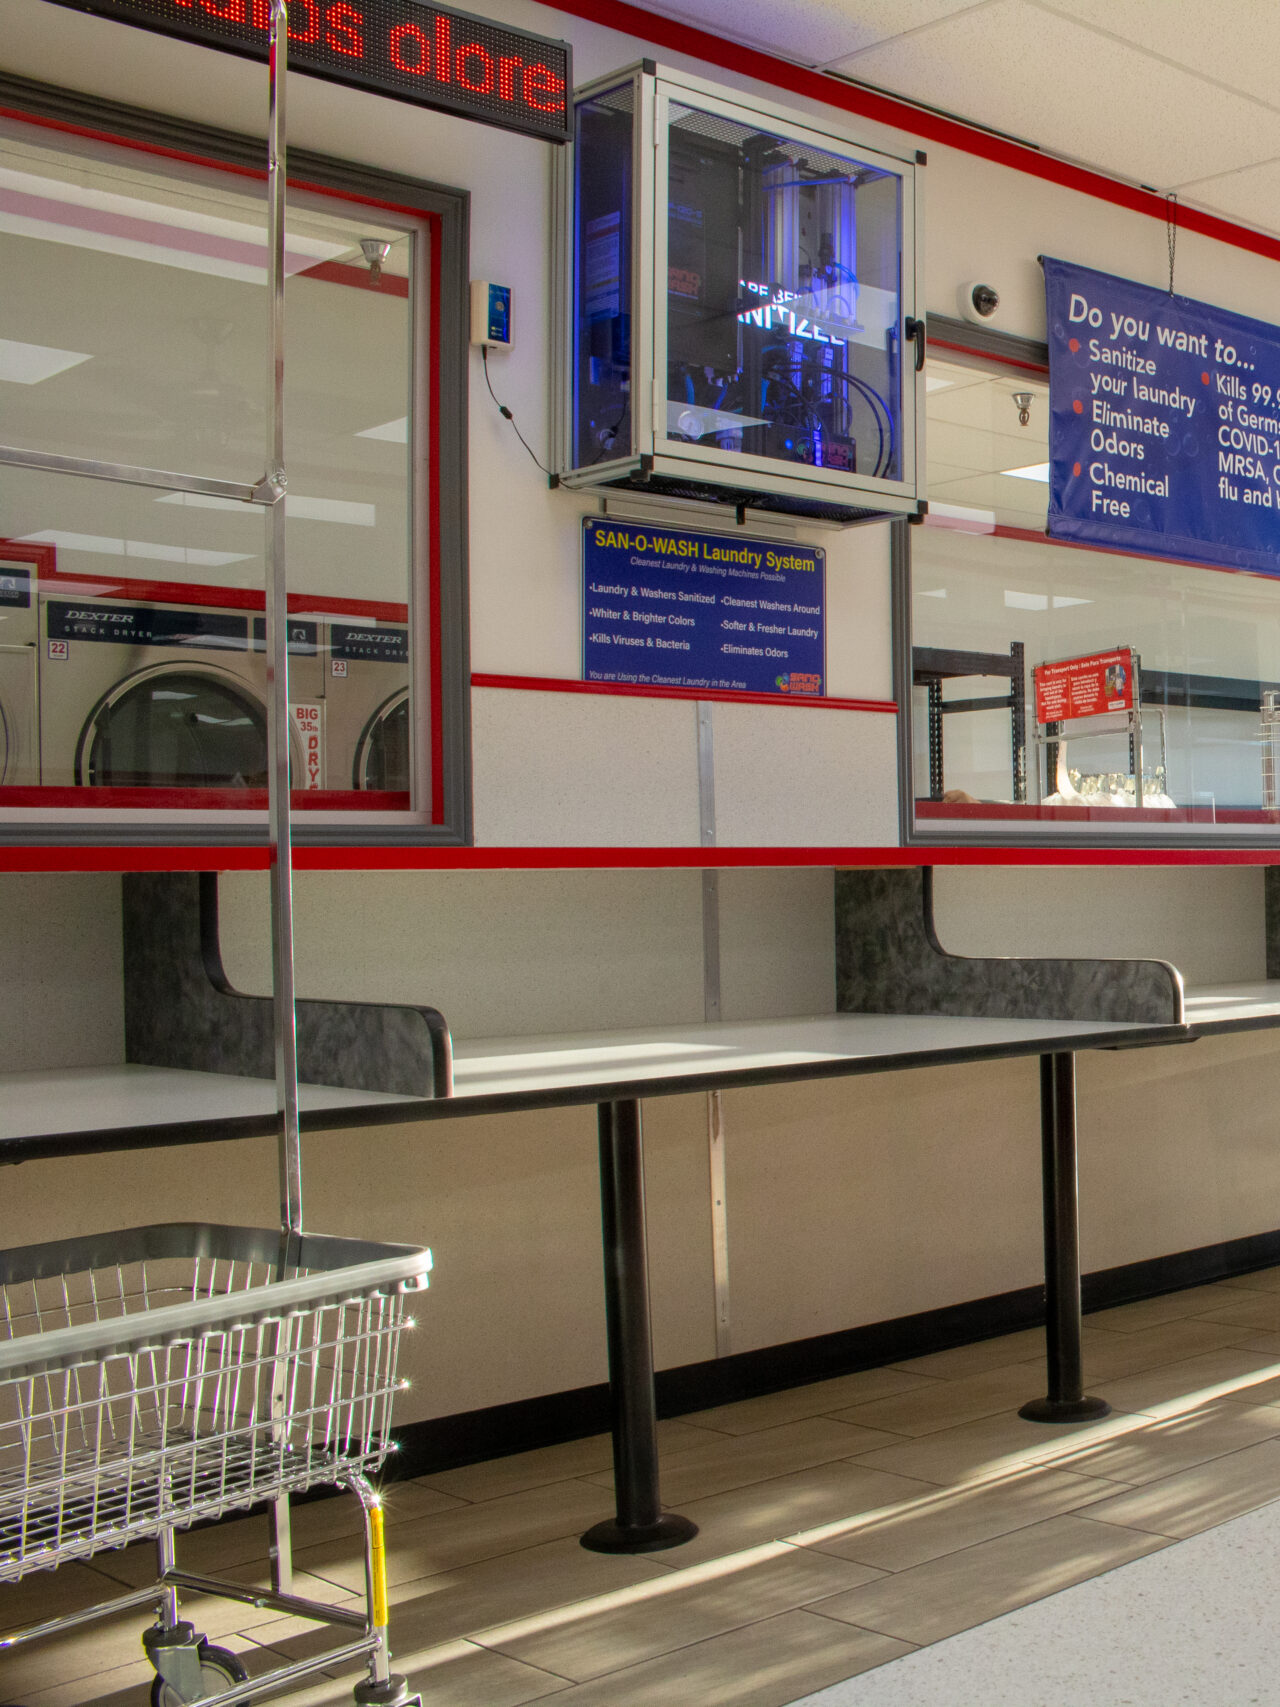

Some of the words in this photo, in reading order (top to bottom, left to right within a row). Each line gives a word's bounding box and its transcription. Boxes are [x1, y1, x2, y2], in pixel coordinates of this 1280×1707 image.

[390, 15, 565, 112] olore
[1068, 293, 1103, 328] Do
[1110, 311, 1150, 341] you
[1156, 325, 1208, 358] want
[1214, 338, 1255, 371] to...
[1088, 338, 1157, 376] Sanitize
[1090, 372, 1128, 397] your
[1133, 377, 1196, 418] laundry
[1215, 373, 1247, 401] Kills
[1092, 400, 1170, 438] Eliminate
[1218, 401, 1233, 421] of
[1090, 429, 1145, 460] Odors
[1218, 451, 1269, 484] MRSA,
[1089, 462, 1169, 498] Chemical
[1218, 476, 1238, 501] flu
[1243, 486, 1272, 508] and
[1091, 490, 1131, 518] Free
[595, 529, 699, 558] SAN-O-WASH
[703, 543, 762, 569] Laundry
[766, 551, 815, 572] System
[630, 556, 661, 568] Cleanest
[662, 560, 690, 573] Laundry
[691, 563, 697, 572] &
[699, 564, 727, 577] Washing
[728, 568, 759, 579] Machines
[760, 572, 786, 582] Possible
[592, 582, 628, 597] Laundry
[630, 586, 638, 596] &
[640, 587, 677, 600] Washers
[678, 591, 716, 604] Sanitized
[723, 596, 757, 608] Cleanest
[759, 600, 791, 612] Washers
[793, 604, 820, 615] Around
[65, 610, 134, 623] DEXTER
[591, 607, 621, 619] Whiter
[623, 610, 630, 620] &
[632, 611, 666, 624] Brighter
[668, 615, 695, 626] Colors
[64, 625, 105, 635] STACK
[114, 629, 153, 638] DRYER
[345, 632, 402, 644] DEXTER
[723, 620, 746, 631] Softer
[748, 622, 755, 632] &
[757, 623, 786, 634] Fresher
[787, 626, 818, 640] Laundry
[51, 643, 65, 654] 22
[345, 646, 379, 655] STACK
[592, 633, 611, 644] Kills
[612, 634, 644, 646] Viruses
[646, 637, 653, 647] &
[655, 638, 690, 650] Bacteria
[723, 644, 763, 656] Eliminates
[765, 647, 789, 658] Odors
[334, 662, 346, 672] 23
[589, 670, 602, 679] You
[603, 672, 616, 680] are
[617, 672, 638, 684] Using
[639, 674, 650, 682] the
[651, 674, 681, 685] Cleanest
[682, 675, 710, 688] Laundry
[711, 678, 718, 686] in
[719, 680, 730, 688] the
[731, 680, 746, 689] Area
[296, 707, 318, 721] BIG
